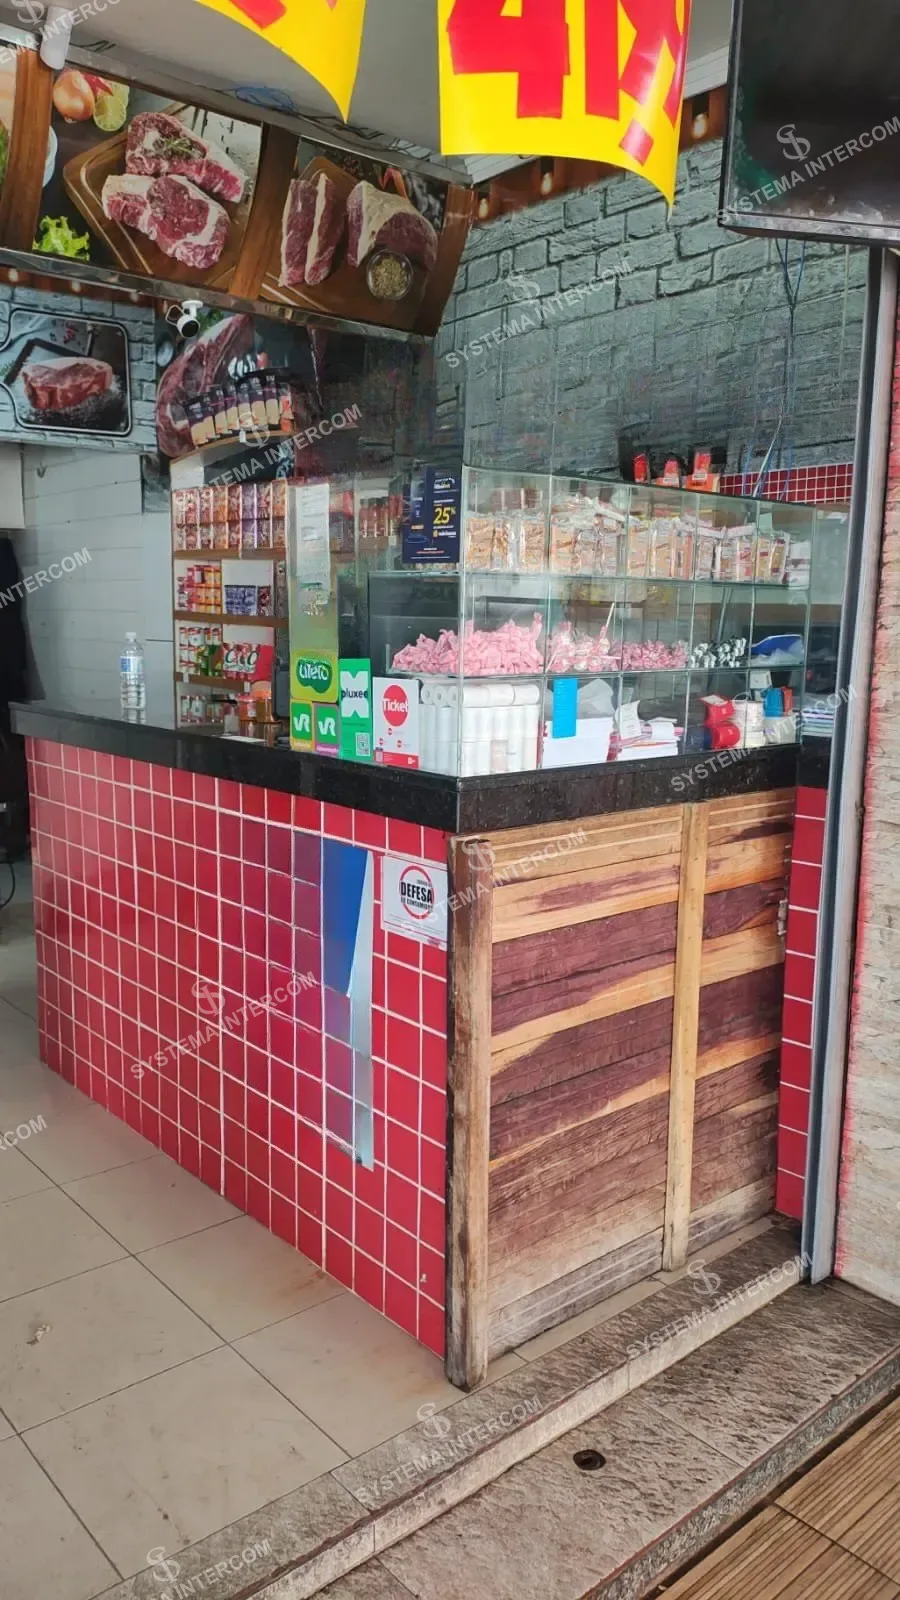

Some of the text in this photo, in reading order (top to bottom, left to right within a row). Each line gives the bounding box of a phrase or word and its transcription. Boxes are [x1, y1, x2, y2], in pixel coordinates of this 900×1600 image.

[341, 687, 368, 701] pluxee
[383, 698, 408, 713] Ticket
[400, 881, 433, 904] DEFESA
